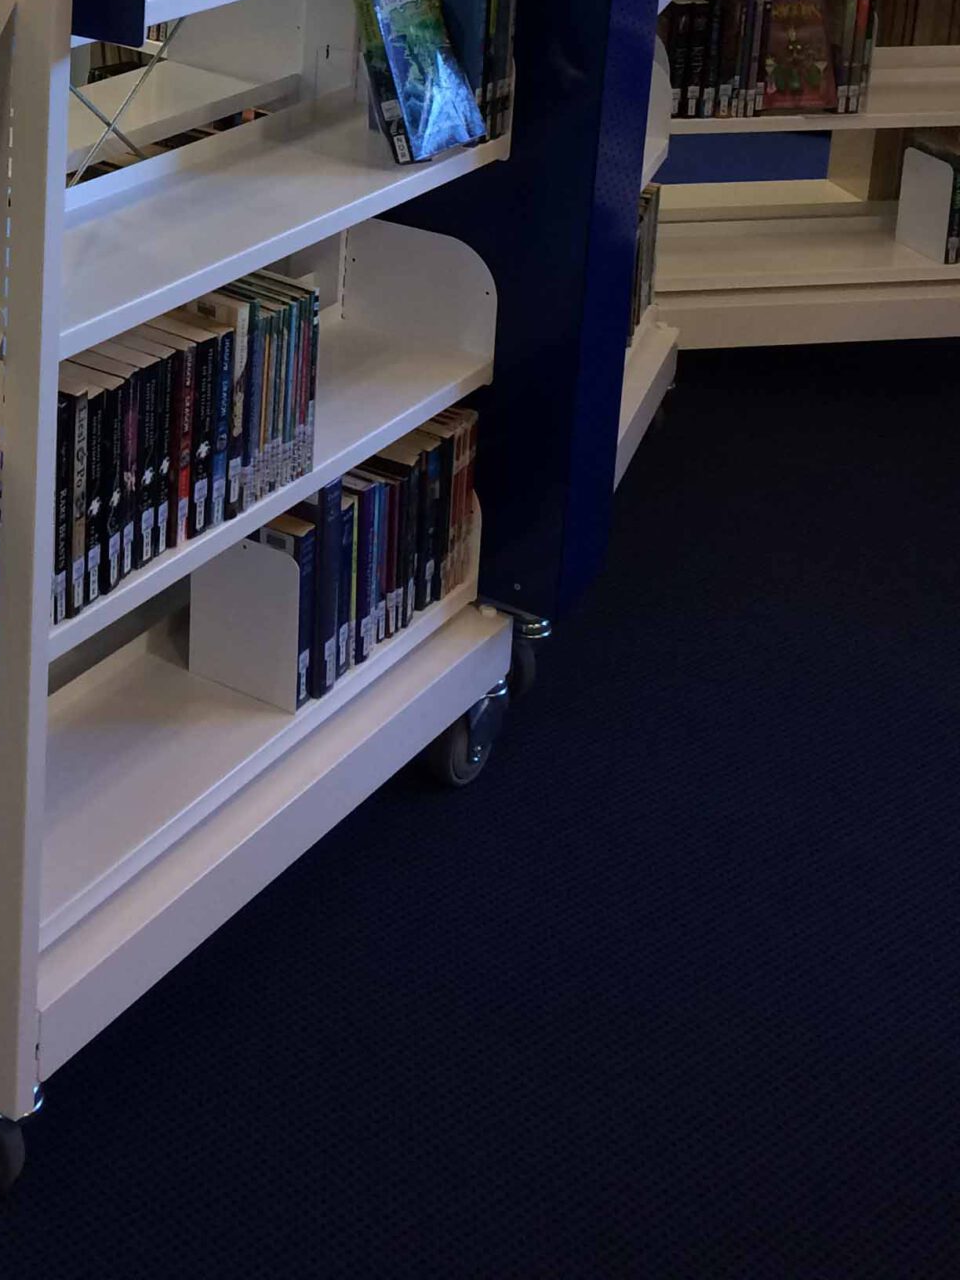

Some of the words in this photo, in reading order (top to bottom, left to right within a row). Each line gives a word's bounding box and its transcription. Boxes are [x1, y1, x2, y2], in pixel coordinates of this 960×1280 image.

[76, 405, 87, 444] Liesl
[75, 467, 84, 489] Po
[59, 487, 68, 522] RARE
[58, 523, 67, 569] BEASTS
